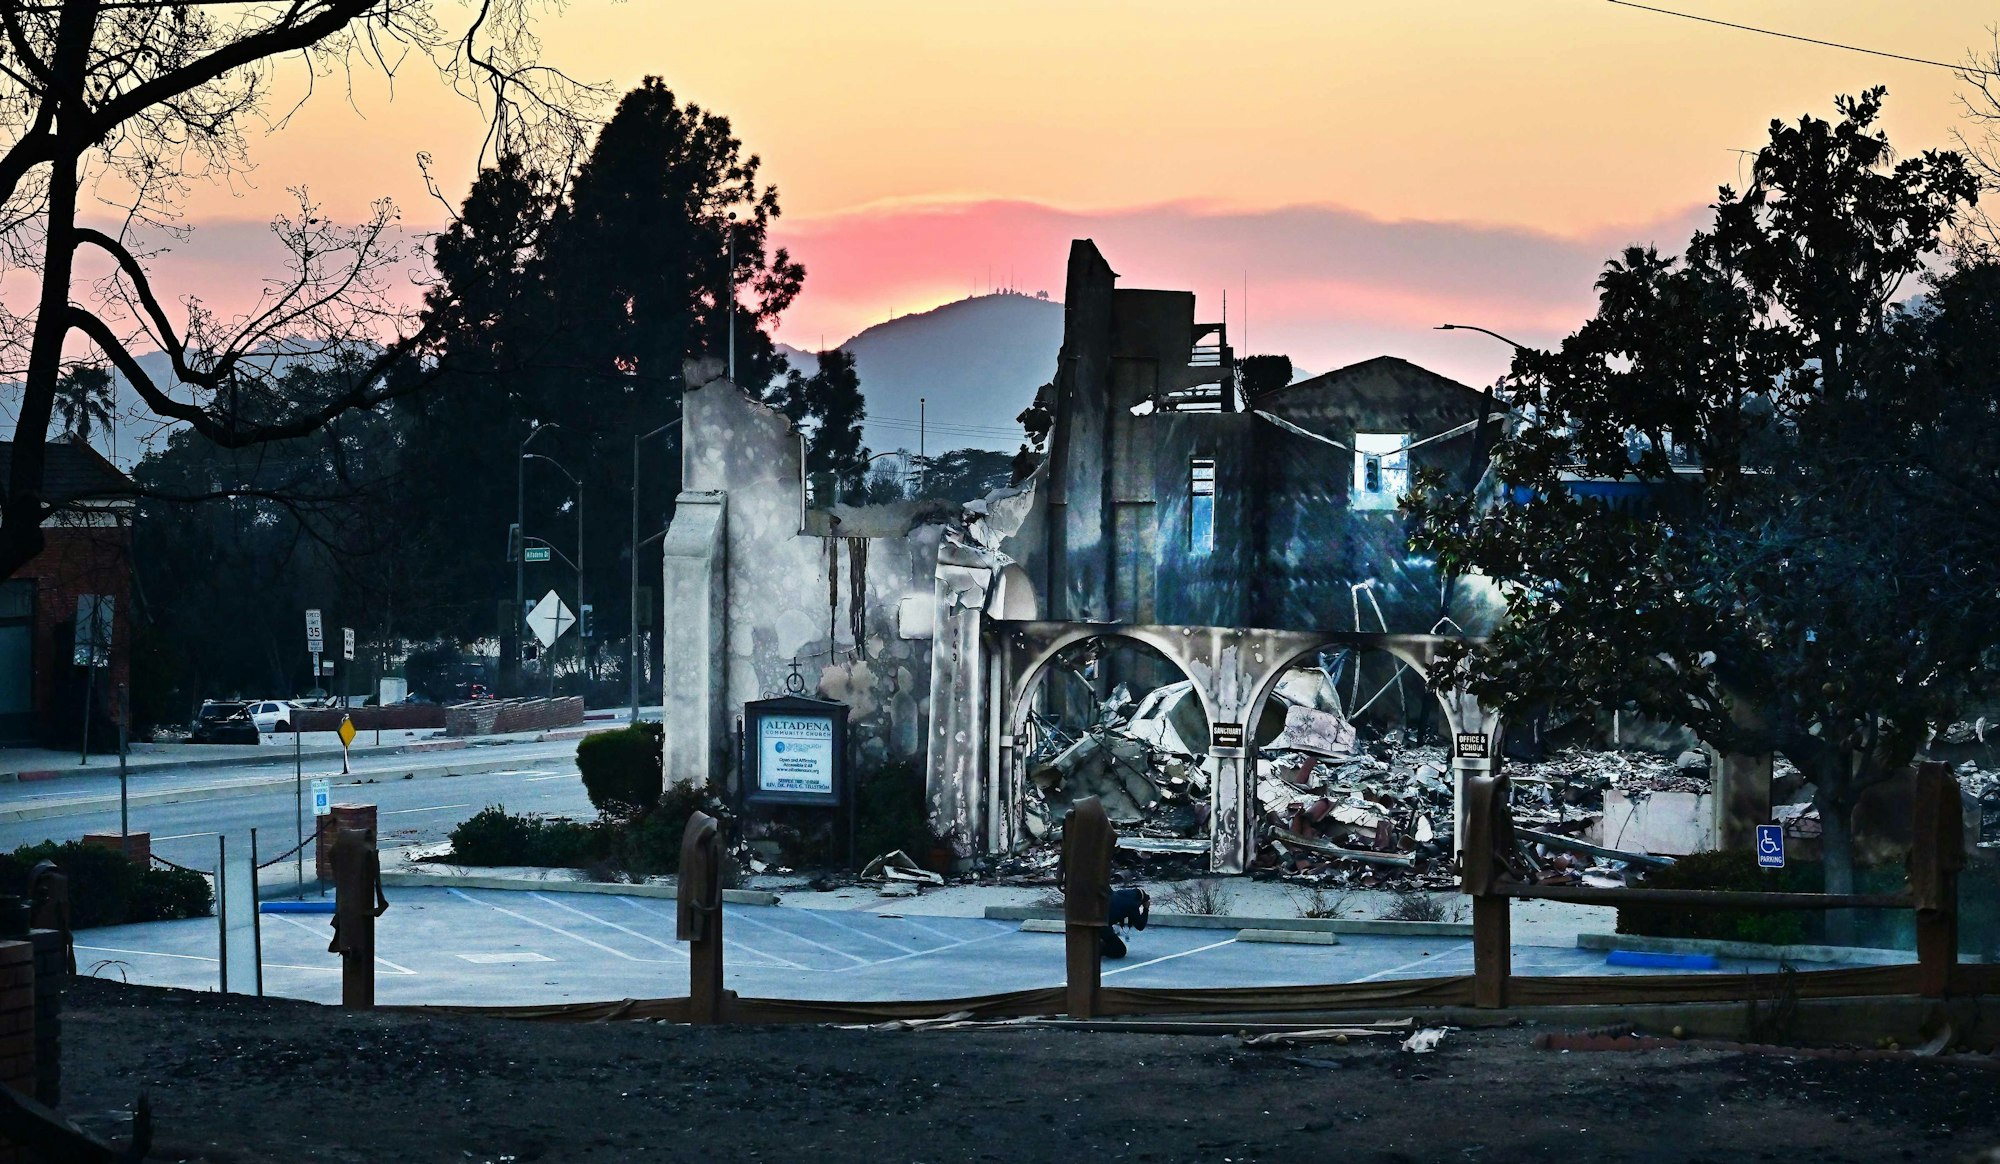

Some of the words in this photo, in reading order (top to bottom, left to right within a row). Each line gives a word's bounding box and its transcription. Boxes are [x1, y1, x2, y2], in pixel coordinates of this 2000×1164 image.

[309, 627, 320, 637] 35
[345, 630, 354, 639] ONE
[766, 721, 831, 731] ALTADENA
[1213, 727, 1242, 735] SANCTUARY
[1459, 735, 1480, 743] OFFICE
[1460, 743, 1485, 751] SCHOOL
